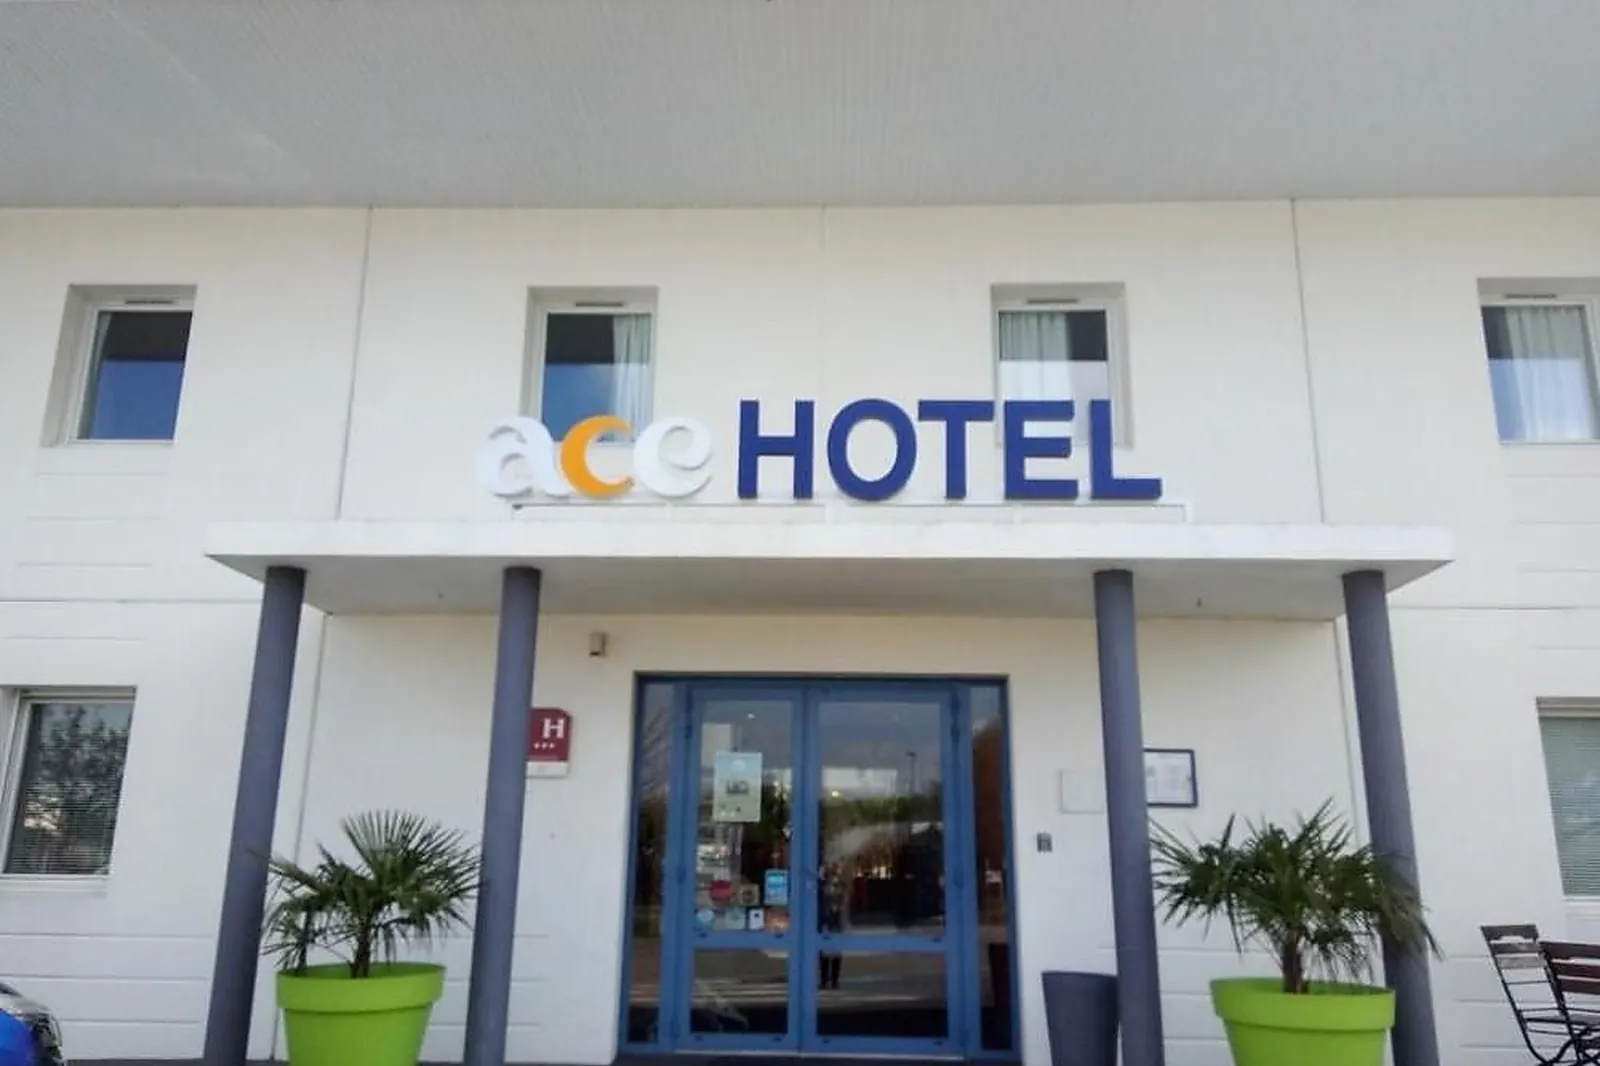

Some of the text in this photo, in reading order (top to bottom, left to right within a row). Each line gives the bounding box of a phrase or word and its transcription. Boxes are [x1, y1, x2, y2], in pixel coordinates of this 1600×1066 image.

[478, 399, 1162, 501] ace HOTEL
[543, 718, 564, 738] H
